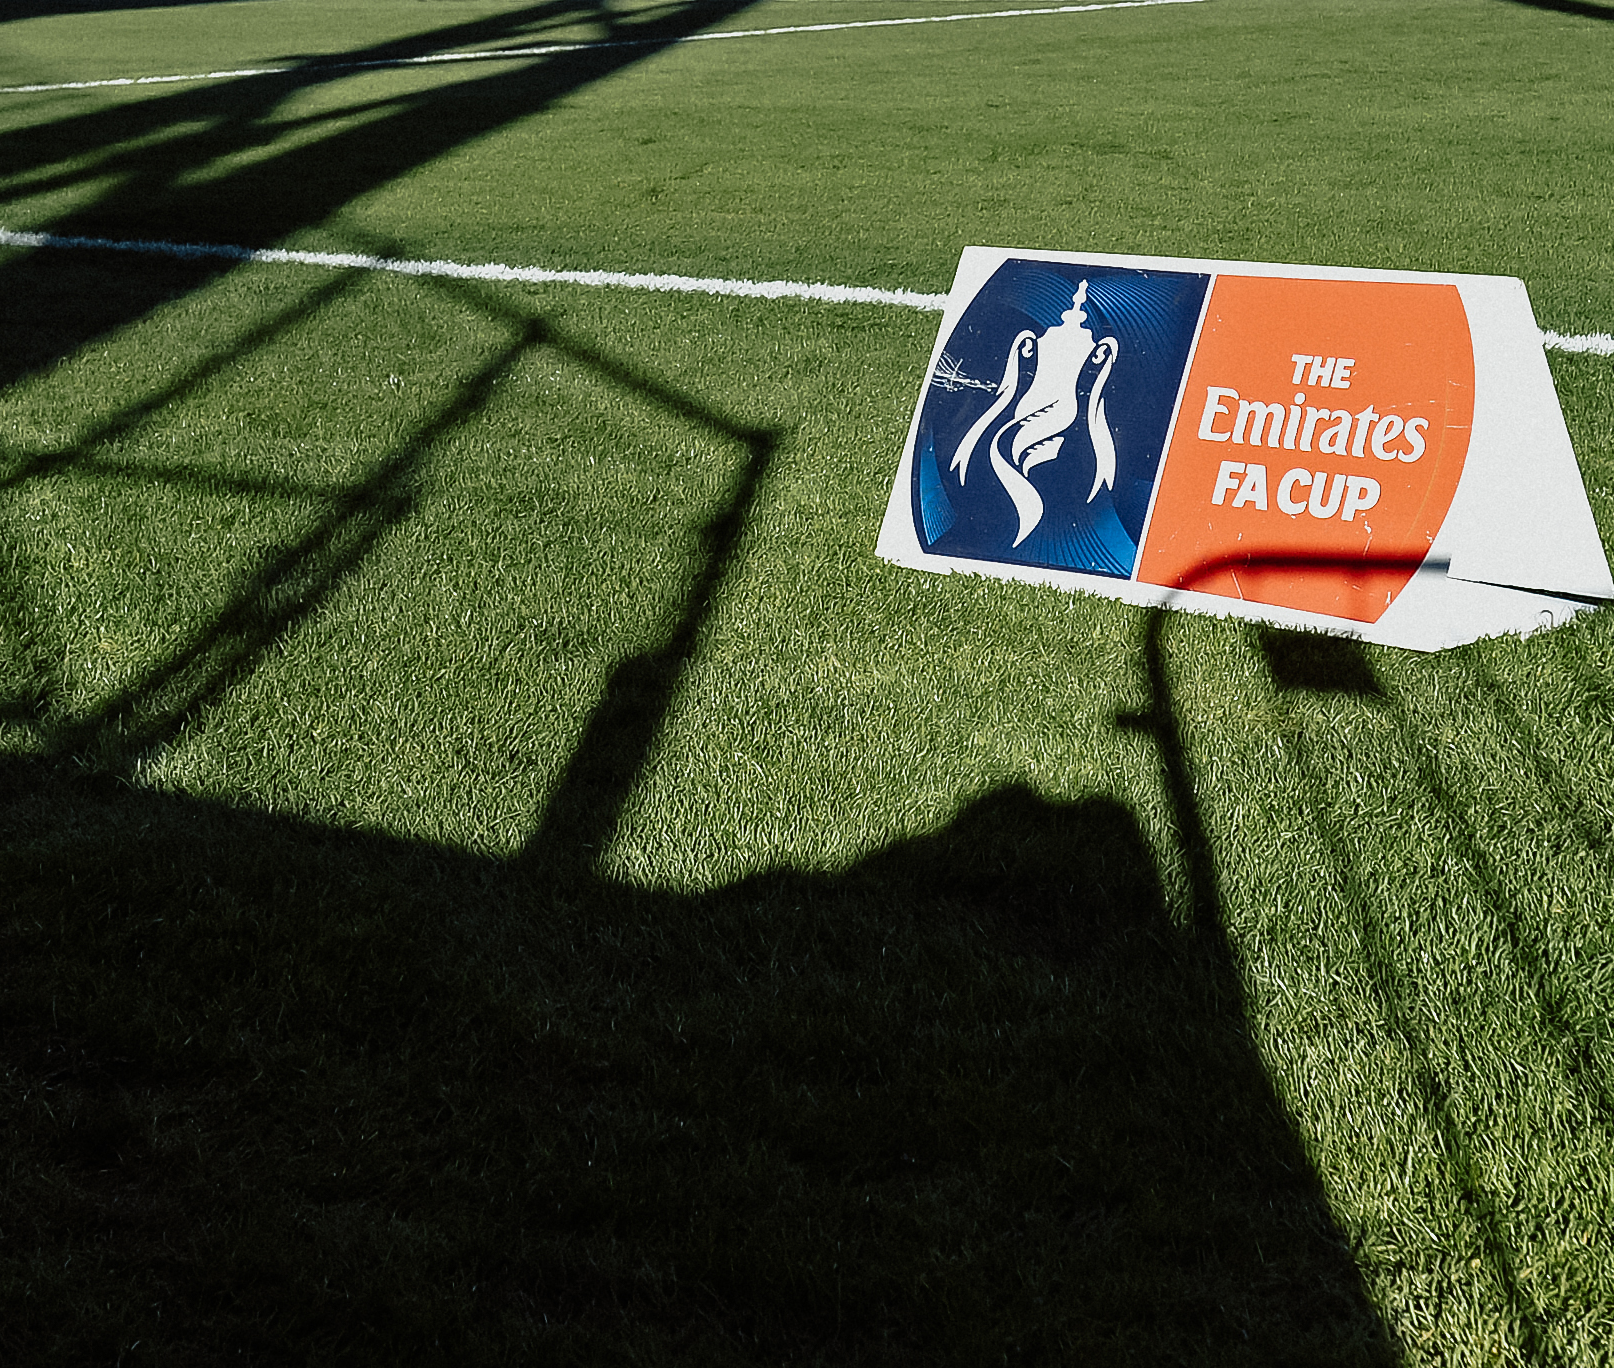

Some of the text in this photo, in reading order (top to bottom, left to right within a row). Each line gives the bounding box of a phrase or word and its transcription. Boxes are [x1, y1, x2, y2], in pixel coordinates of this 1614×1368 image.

[1291, 353, 1356, 390] THE
[1197, 385, 1429, 464] Emirates
[1211, 460, 1381, 521] FA CUP
